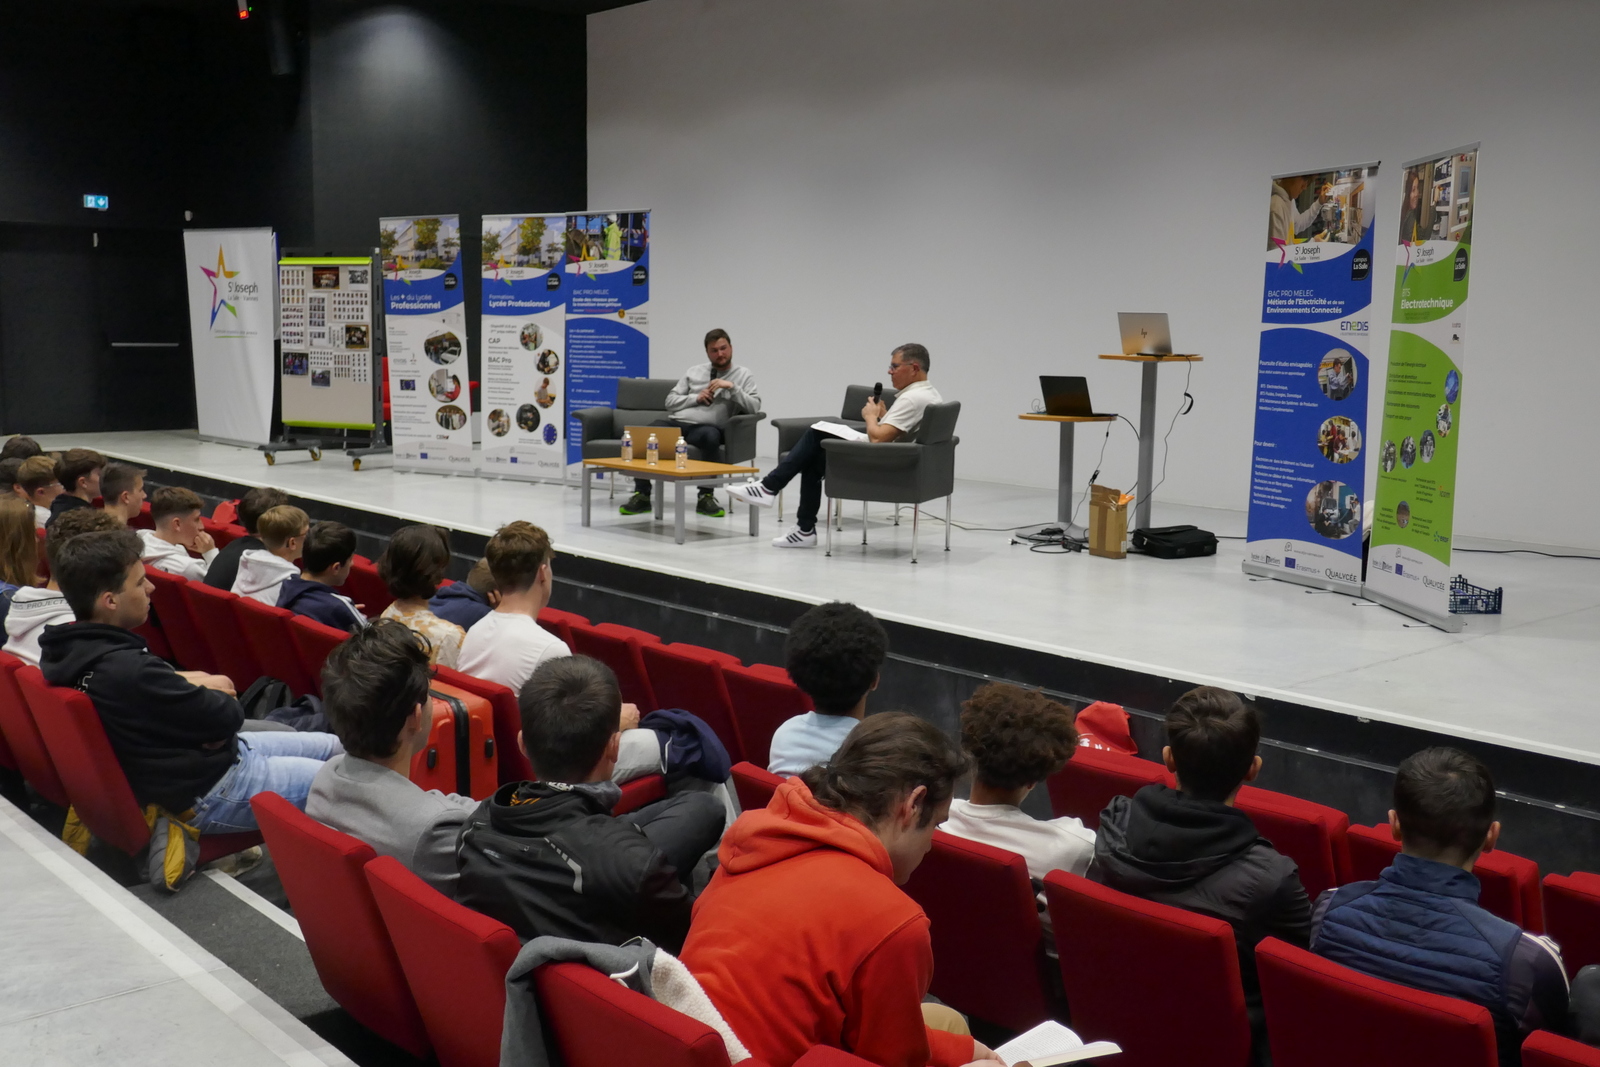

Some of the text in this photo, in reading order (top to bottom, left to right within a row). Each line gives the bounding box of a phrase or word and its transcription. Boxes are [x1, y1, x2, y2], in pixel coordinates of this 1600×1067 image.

[1301, 246, 1320, 256] Joseph
[1421, 247, 1434, 258] Joseph
[234, 281, 258, 296] Joseph
[1402, 288, 1410, 297] BTS
[416, 294, 432, 302] Lycée
[391, 300, 441, 310] Professionnel
[489, 300, 507, 308] Lycée
[1401, 297, 1454, 310] Electrotechnique
[1296, 563, 1320, 574] Erasmus+
[26, 600, 64, 610] PROJECT
